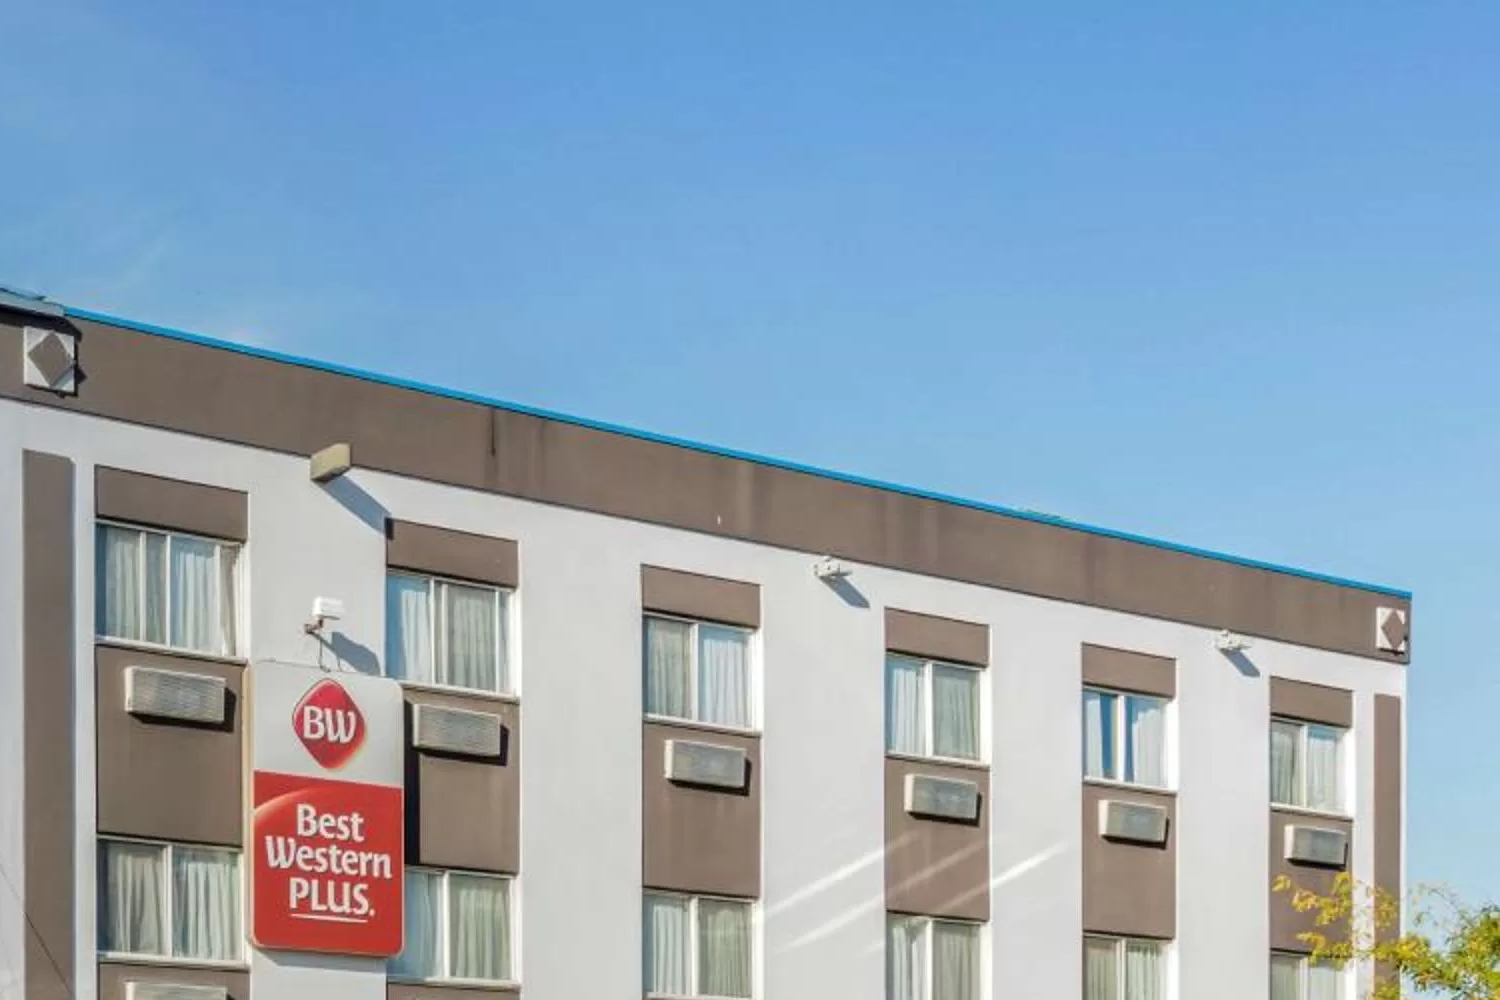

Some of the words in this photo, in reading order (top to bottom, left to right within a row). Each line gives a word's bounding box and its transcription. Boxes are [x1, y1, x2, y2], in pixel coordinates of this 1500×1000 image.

[302, 705, 357, 745] BW
[296, 803, 365, 842] Best
[264, 835, 393, 880] Western
